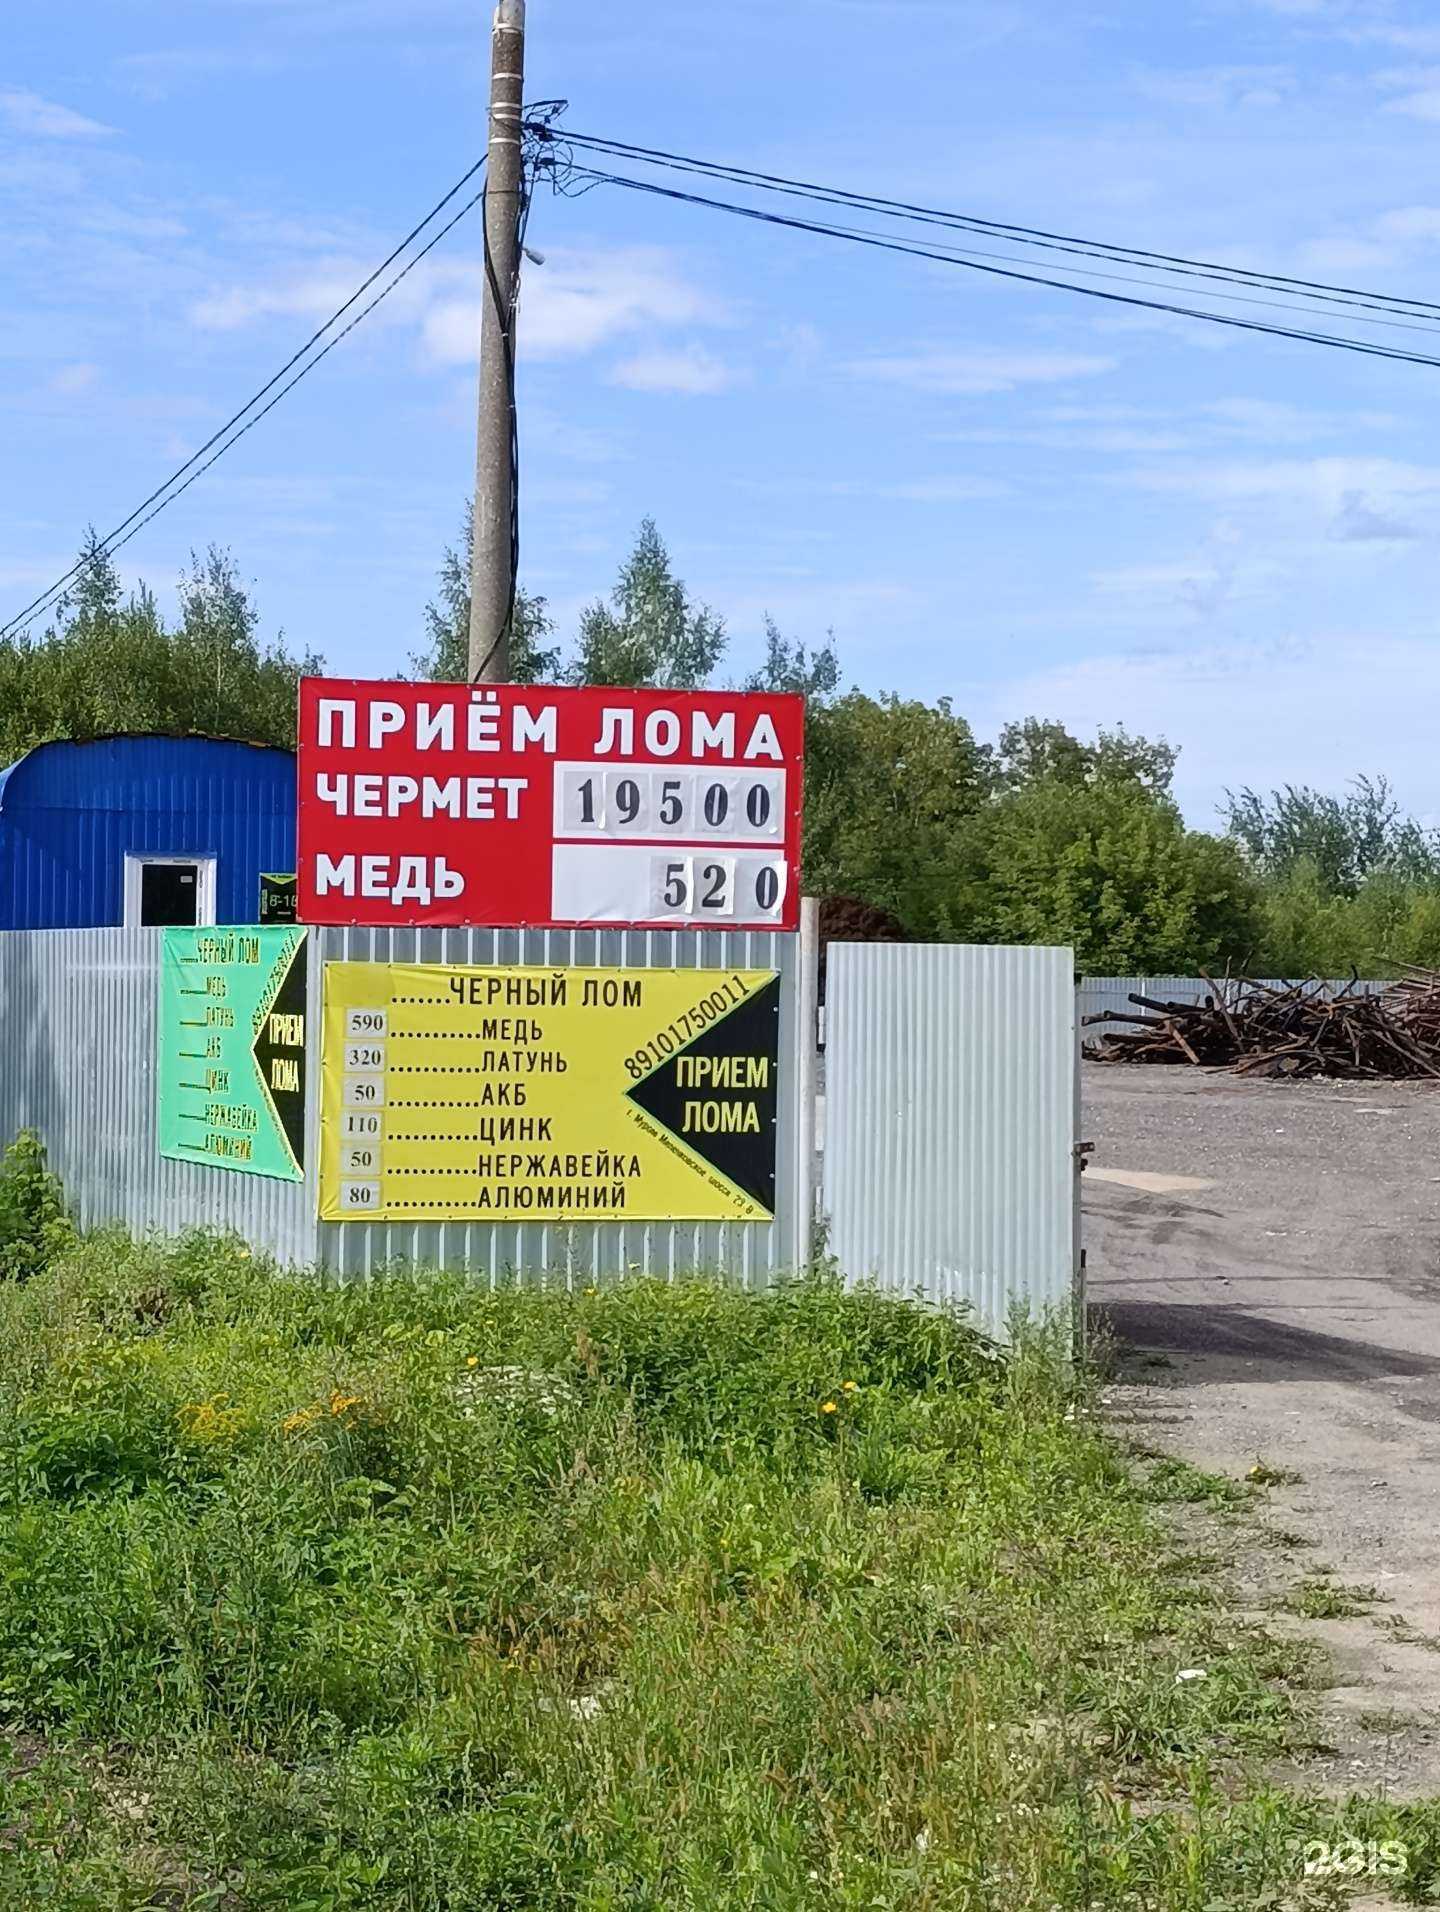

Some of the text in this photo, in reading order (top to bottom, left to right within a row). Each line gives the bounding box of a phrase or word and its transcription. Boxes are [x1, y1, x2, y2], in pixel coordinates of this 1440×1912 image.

[317, 690, 785, 761] ПРИЁМ ЛОМА
[316, 772, 770, 827] ЧЕРМЕТ 19500
[316, 854, 466, 906] МЕДЬ
[665, 863, 780, 911] 520
[581, 980, 642, 1007] ЛОМ
[269, 1014, 304, 1046] ПРИЕМ
[351, 1014, 383, 1032] 590
[624, 975, 750, 1079] 89101750011
[349, 1049, 381, 1066] 320
[676, 1056, 768, 1088] ПРИЕМ
[271, 1059, 299, 1092] ЛОМА
[354, 1085, 376, 1101] 50
[346, 1116, 378, 1133] 110
[682, 1101, 760, 1133] ЛОМА
[350, 1151, 372, 1167] 50
[349, 1188, 371, 1204] 80
